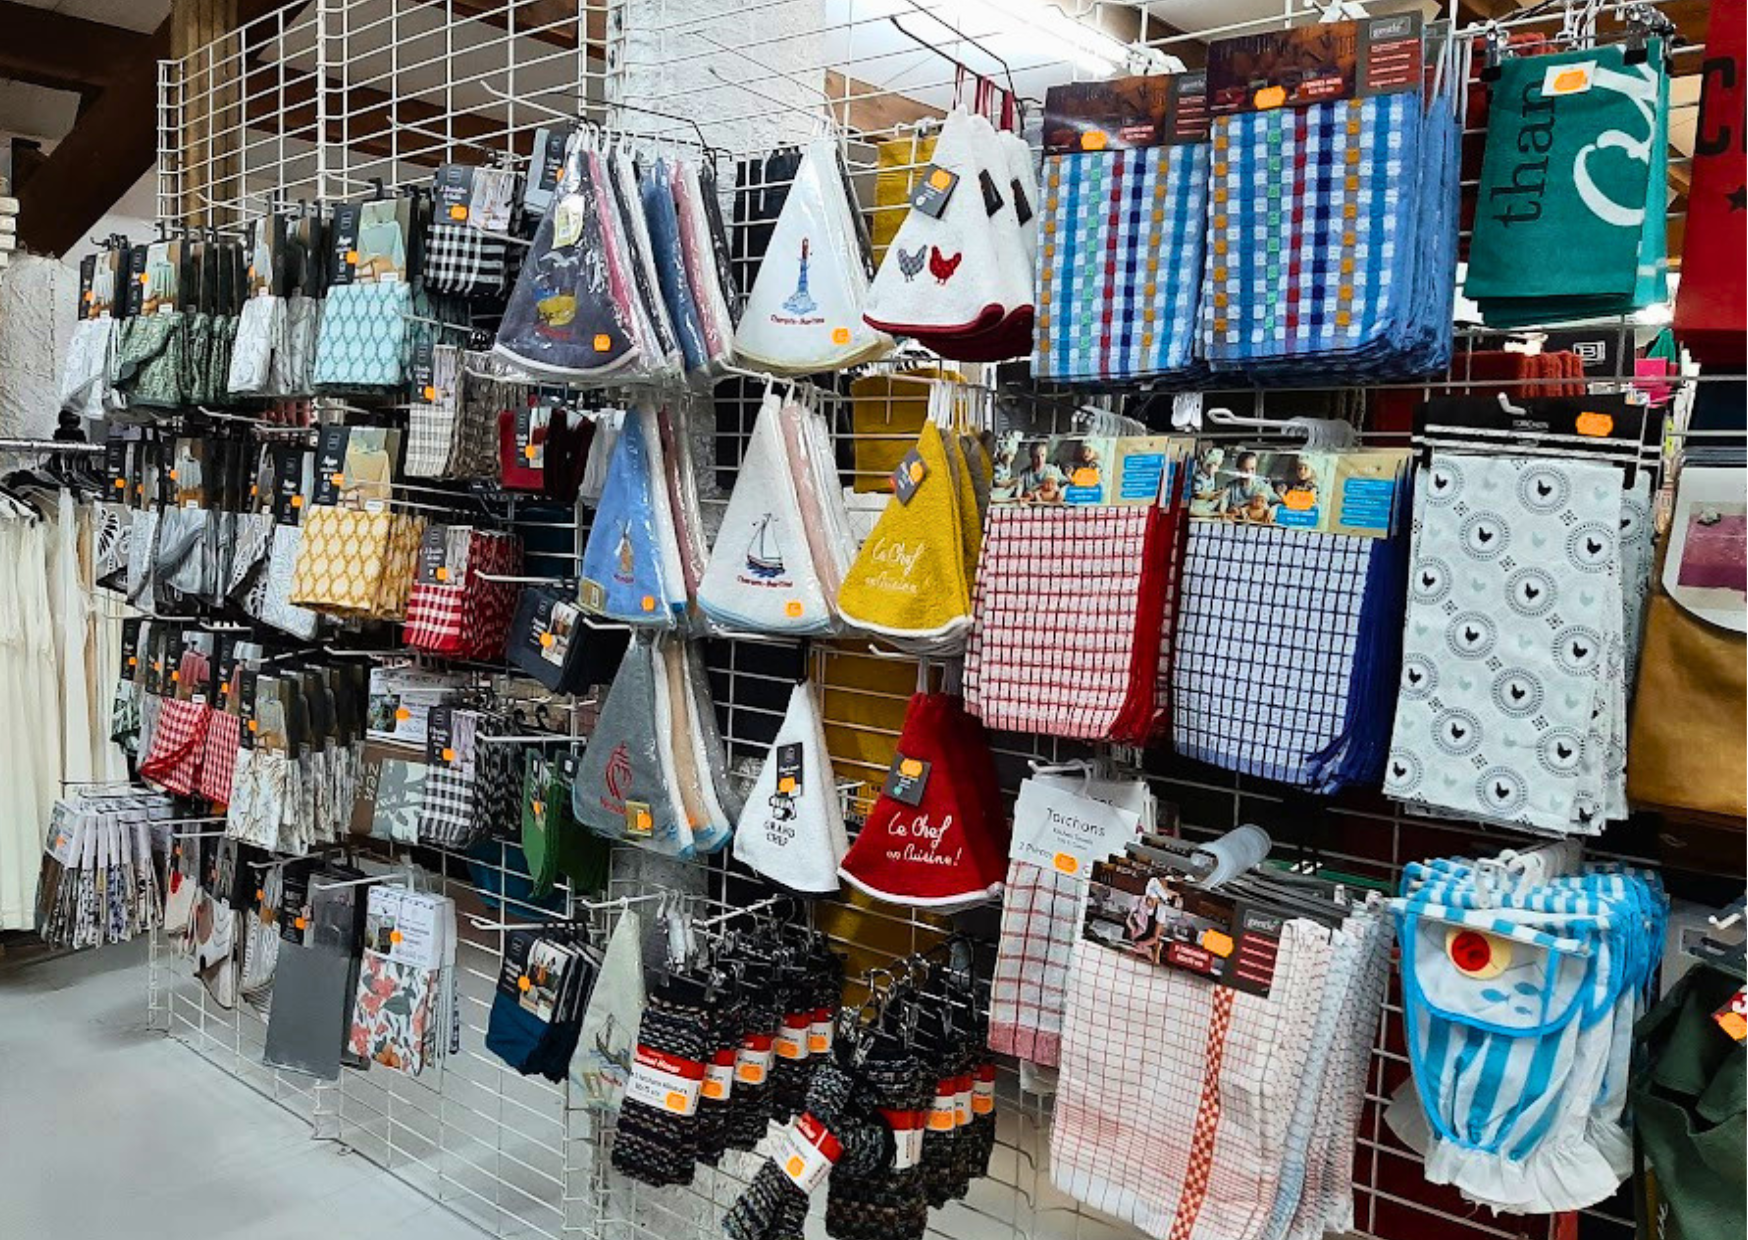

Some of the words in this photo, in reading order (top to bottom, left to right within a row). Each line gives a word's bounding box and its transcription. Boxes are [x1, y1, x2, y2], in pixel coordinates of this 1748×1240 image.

[1491, 79, 1557, 229] than
[888, 542, 924, 577] Chef
[888, 811, 908, 836] Le
[912, 814, 952, 850] Chef
[1047, 807, 1106, 837] Torchons
